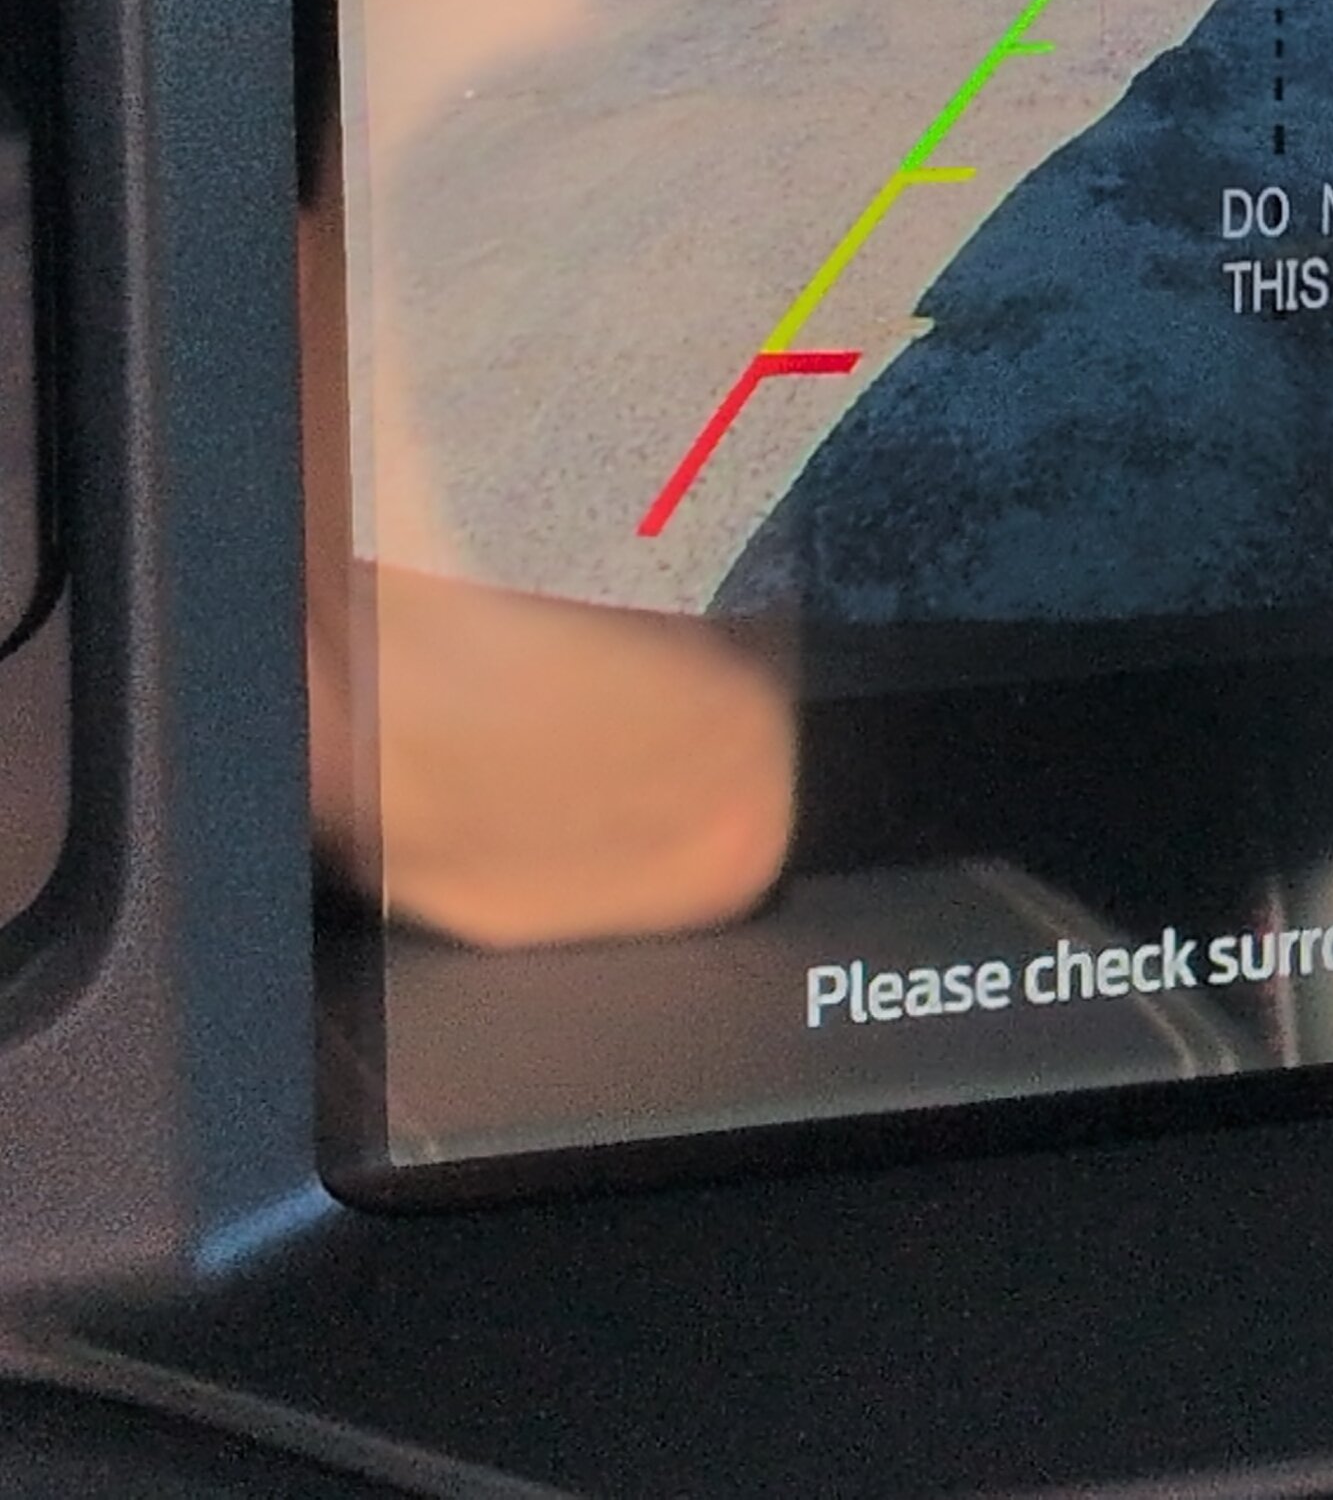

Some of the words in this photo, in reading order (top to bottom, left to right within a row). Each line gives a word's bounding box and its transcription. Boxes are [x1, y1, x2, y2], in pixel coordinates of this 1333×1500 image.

[1222, 186, 1290, 239] DO
[1222, 257, 1329, 313] THIS
[806, 960, 1011, 1029] Please
[1024, 927, 1199, 1006] check
